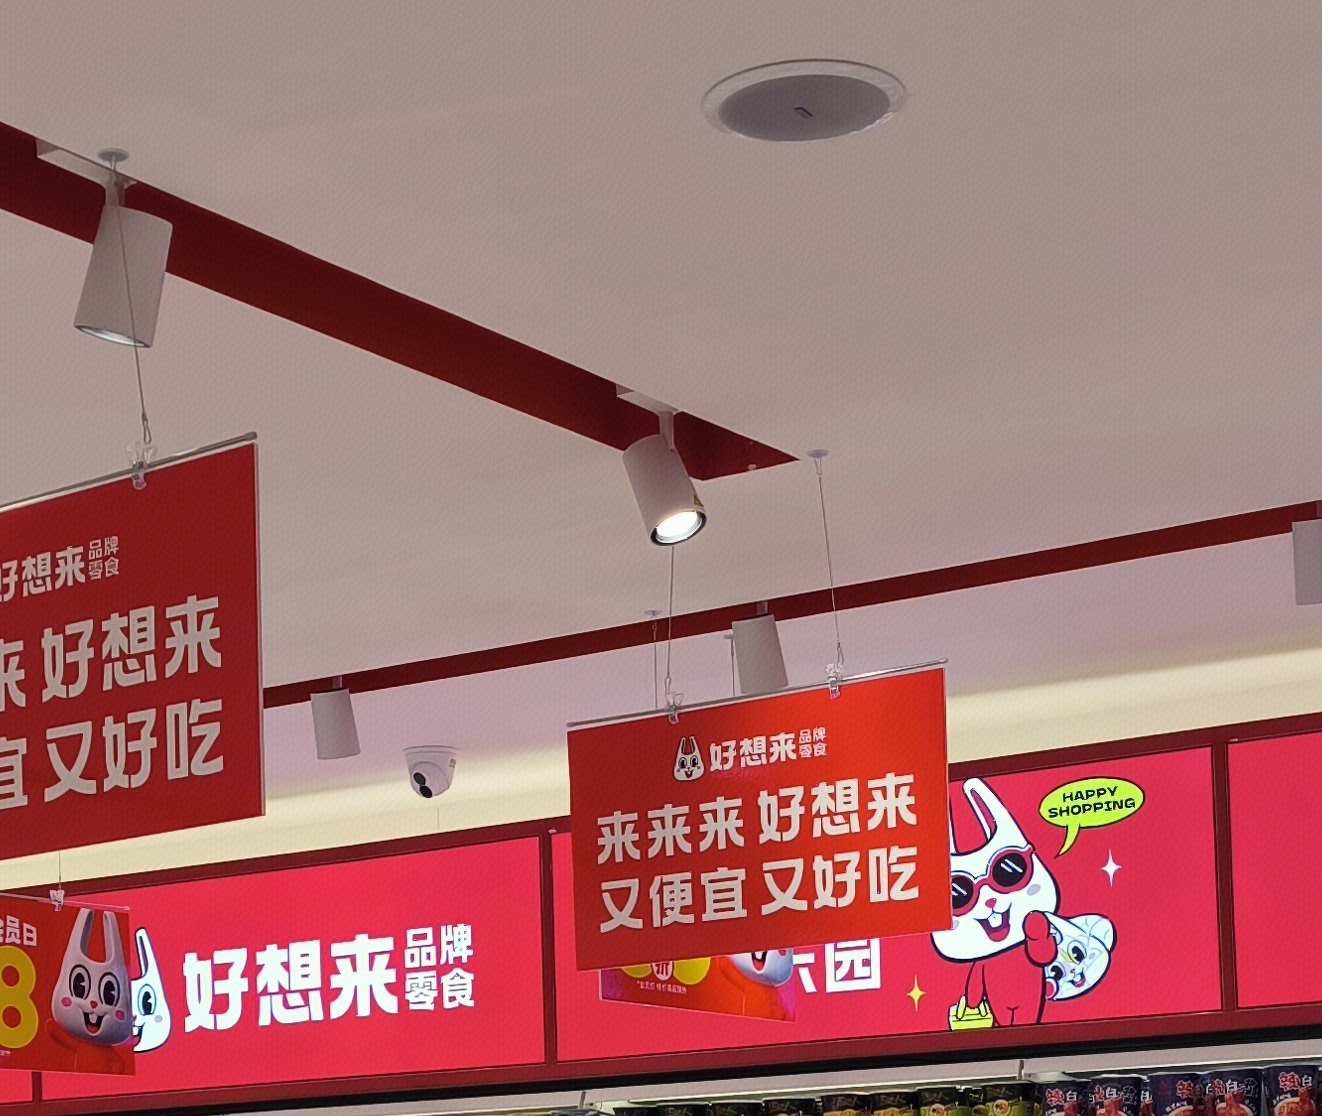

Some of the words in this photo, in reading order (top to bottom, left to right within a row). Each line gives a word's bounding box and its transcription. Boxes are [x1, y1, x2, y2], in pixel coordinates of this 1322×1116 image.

[88, 535, 120, 558] 品牌
[88, 556, 120, 580] 零食
[41, 594, 222, 702] 好想来
[44, 698, 224, 802] 又好吃
[710, 732, 797, 772] 好想来
[1048, 798, 1136, 819] SHOPPING
[1062, 786, 1118, 803] HAPPY
[596, 796, 745, 866] 来来来
[758, 772, 918, 845] 好想来
[600, 868, 747, 933] 又便宜
[761, 845, 919, 916] 又好吃
[405, 924, 474, 969] 品牌
[183, 933, 398, 1033] 好想来
[405, 967, 475, 1011] 零食
